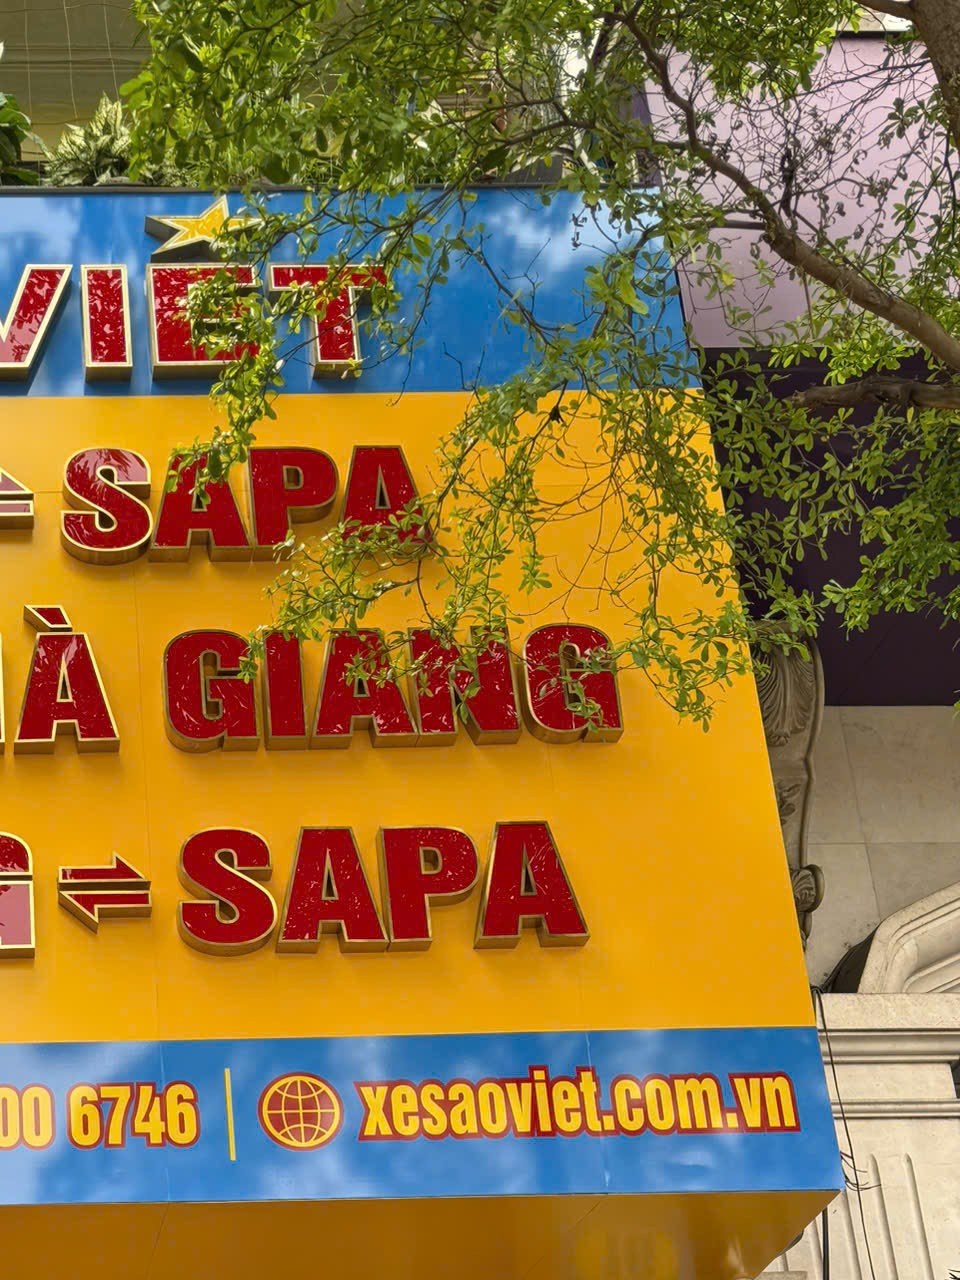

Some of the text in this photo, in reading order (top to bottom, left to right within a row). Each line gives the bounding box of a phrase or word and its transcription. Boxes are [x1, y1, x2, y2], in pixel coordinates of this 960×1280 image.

[60, 445, 437, 565] SAPA
[163, 622, 625, 754] GIANG
[177, 820, 590, 956] SAPA
[66, 1079, 201, 1150] 6746
[356, 1065, 803, 1142] xesaoviet.com.vn
